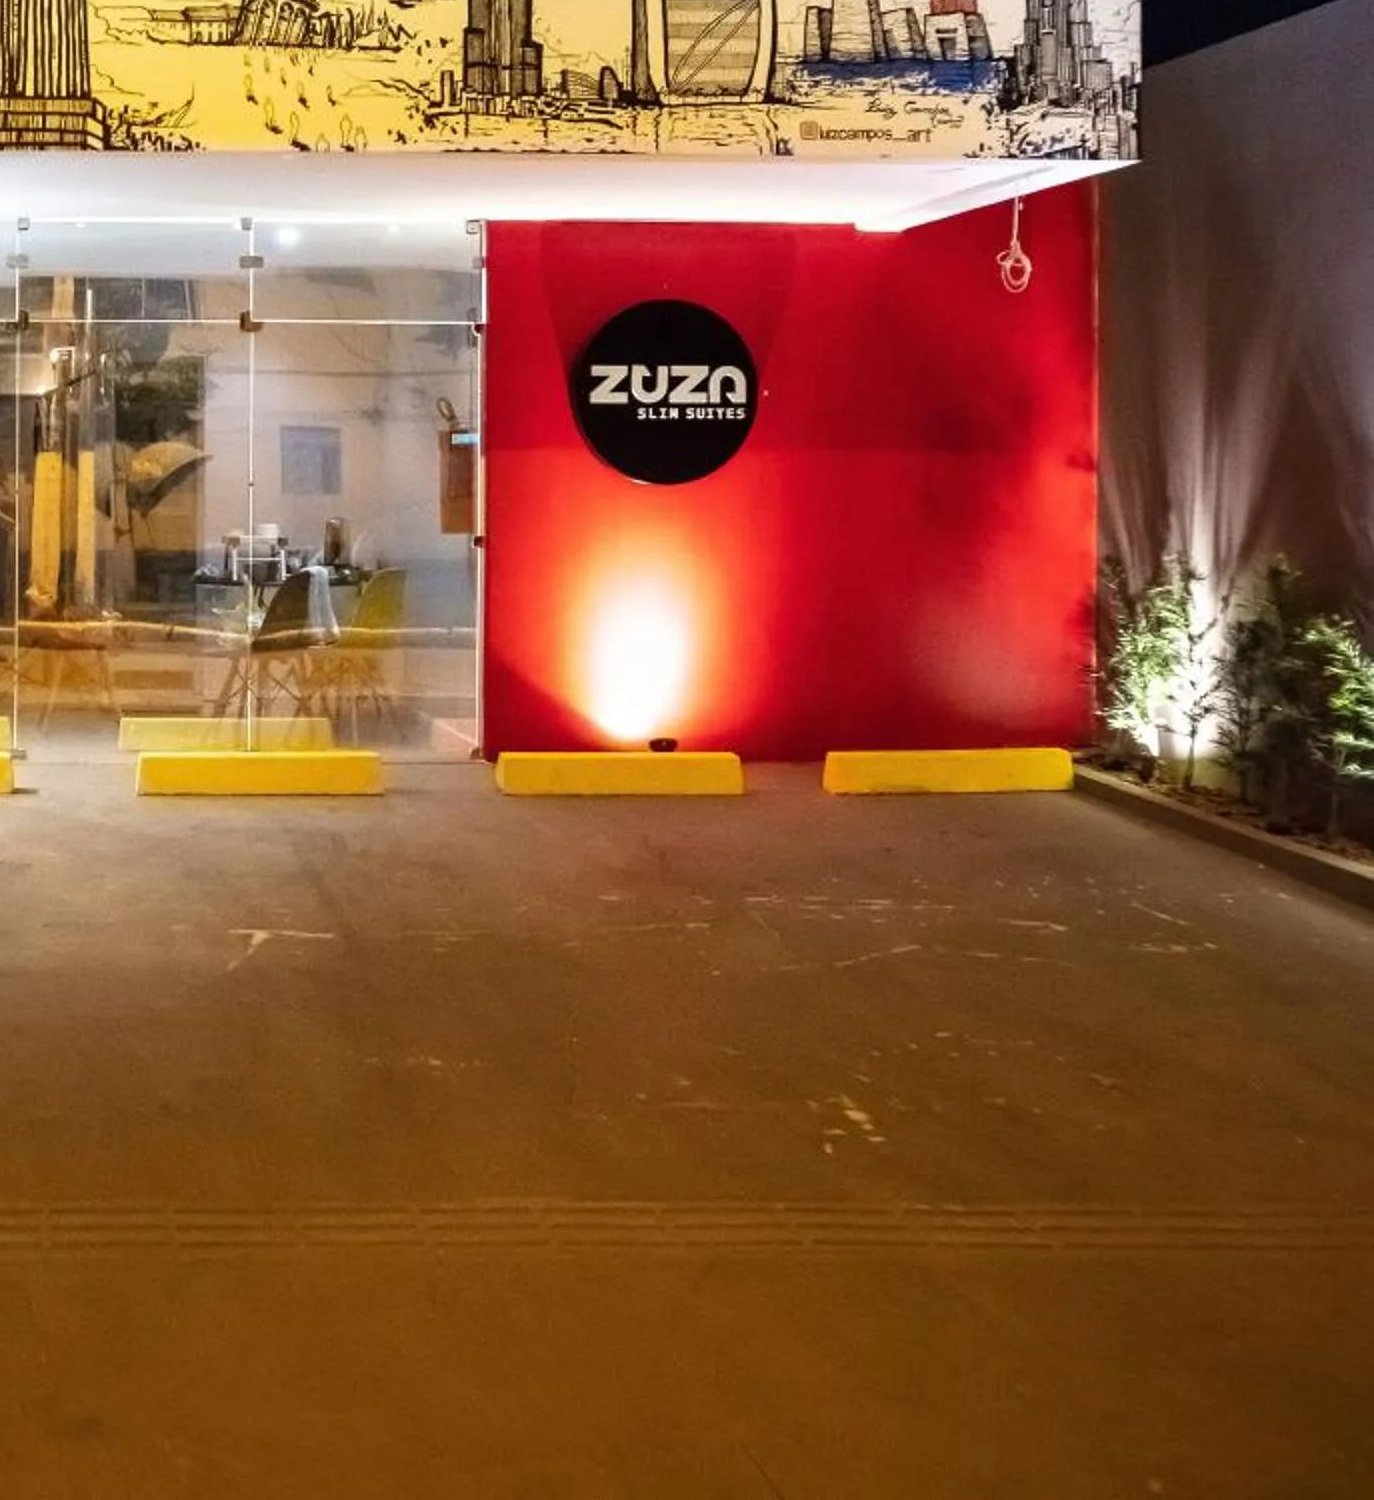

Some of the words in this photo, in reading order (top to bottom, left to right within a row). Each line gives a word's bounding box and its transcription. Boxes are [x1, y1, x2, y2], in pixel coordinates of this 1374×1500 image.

[589, 364, 747, 404] ZUZA
[637, 407, 679, 420] SLIM
[685, 407, 746, 420] SUITES
